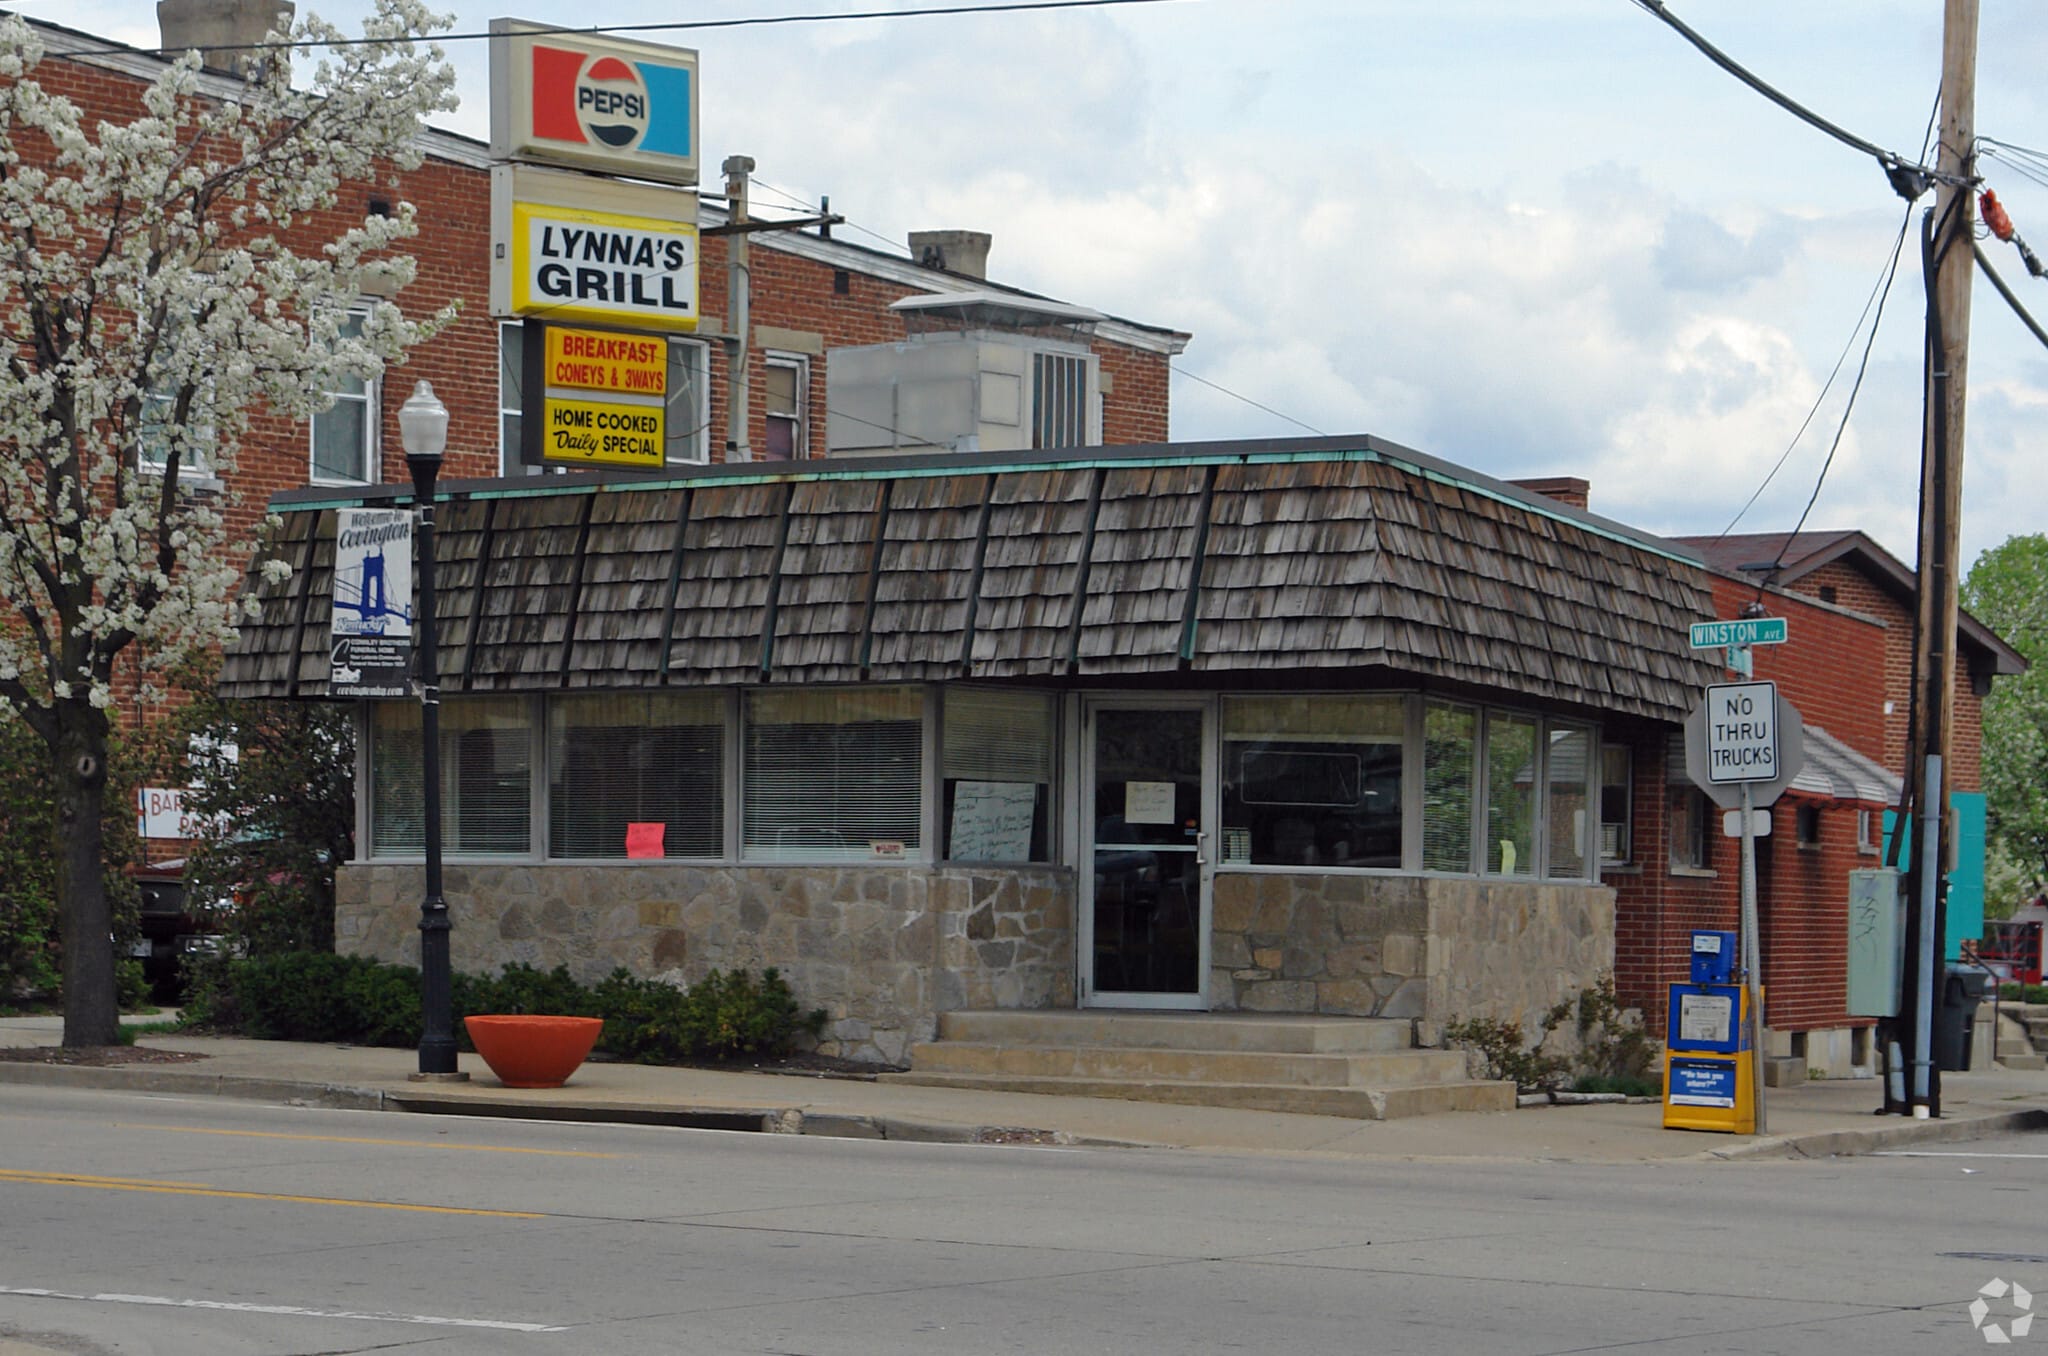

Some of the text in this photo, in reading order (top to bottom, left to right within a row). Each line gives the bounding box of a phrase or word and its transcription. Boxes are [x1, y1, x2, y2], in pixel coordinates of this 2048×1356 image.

[578, 86, 645, 119] PEPSI
[541, 225, 685, 271] LYNNA'S
[537, 263, 689, 309] GRILL
[562, 335, 658, 364] BREAKFAST
[556, 362, 664, 391] CONEYS & 3WAYS
[554, 408, 658, 433] HOME COOKED
[553, 430, 658, 456] Daily SPECIAL
[351, 511, 393, 527] Welcome
[339, 523, 409, 550] Covington
[1694, 624, 1781, 644] WINSTON AVE
[1726, 698, 1753, 716] NO
[1716, 723, 1766, 741] THRU
[1714, 748, 1772, 767] TRUCKS
